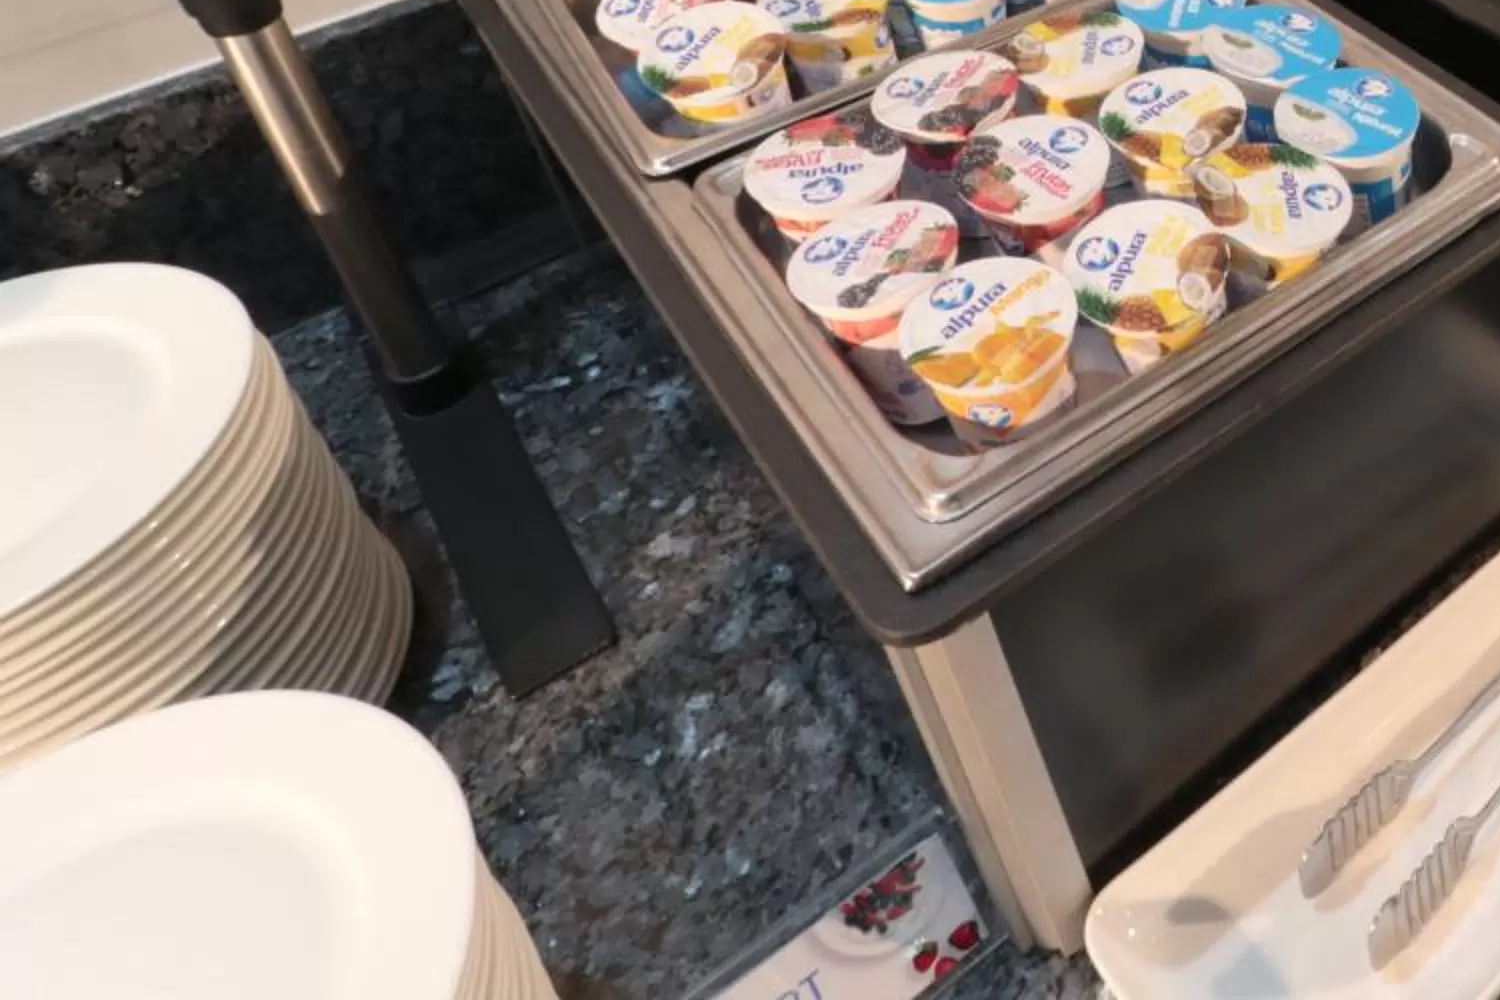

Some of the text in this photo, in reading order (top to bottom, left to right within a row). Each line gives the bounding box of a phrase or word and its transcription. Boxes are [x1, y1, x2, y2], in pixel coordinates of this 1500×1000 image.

[675, 26, 723, 72] alpura
[1135, 89, 1191, 125] alpura
[1018, 136, 1072, 171] alpura
[1276, 170, 1303, 221] alpura
[833, 228, 877, 277] alpura
[1109, 229, 1148, 292] alpura
[940, 280, 1009, 340] alpura
